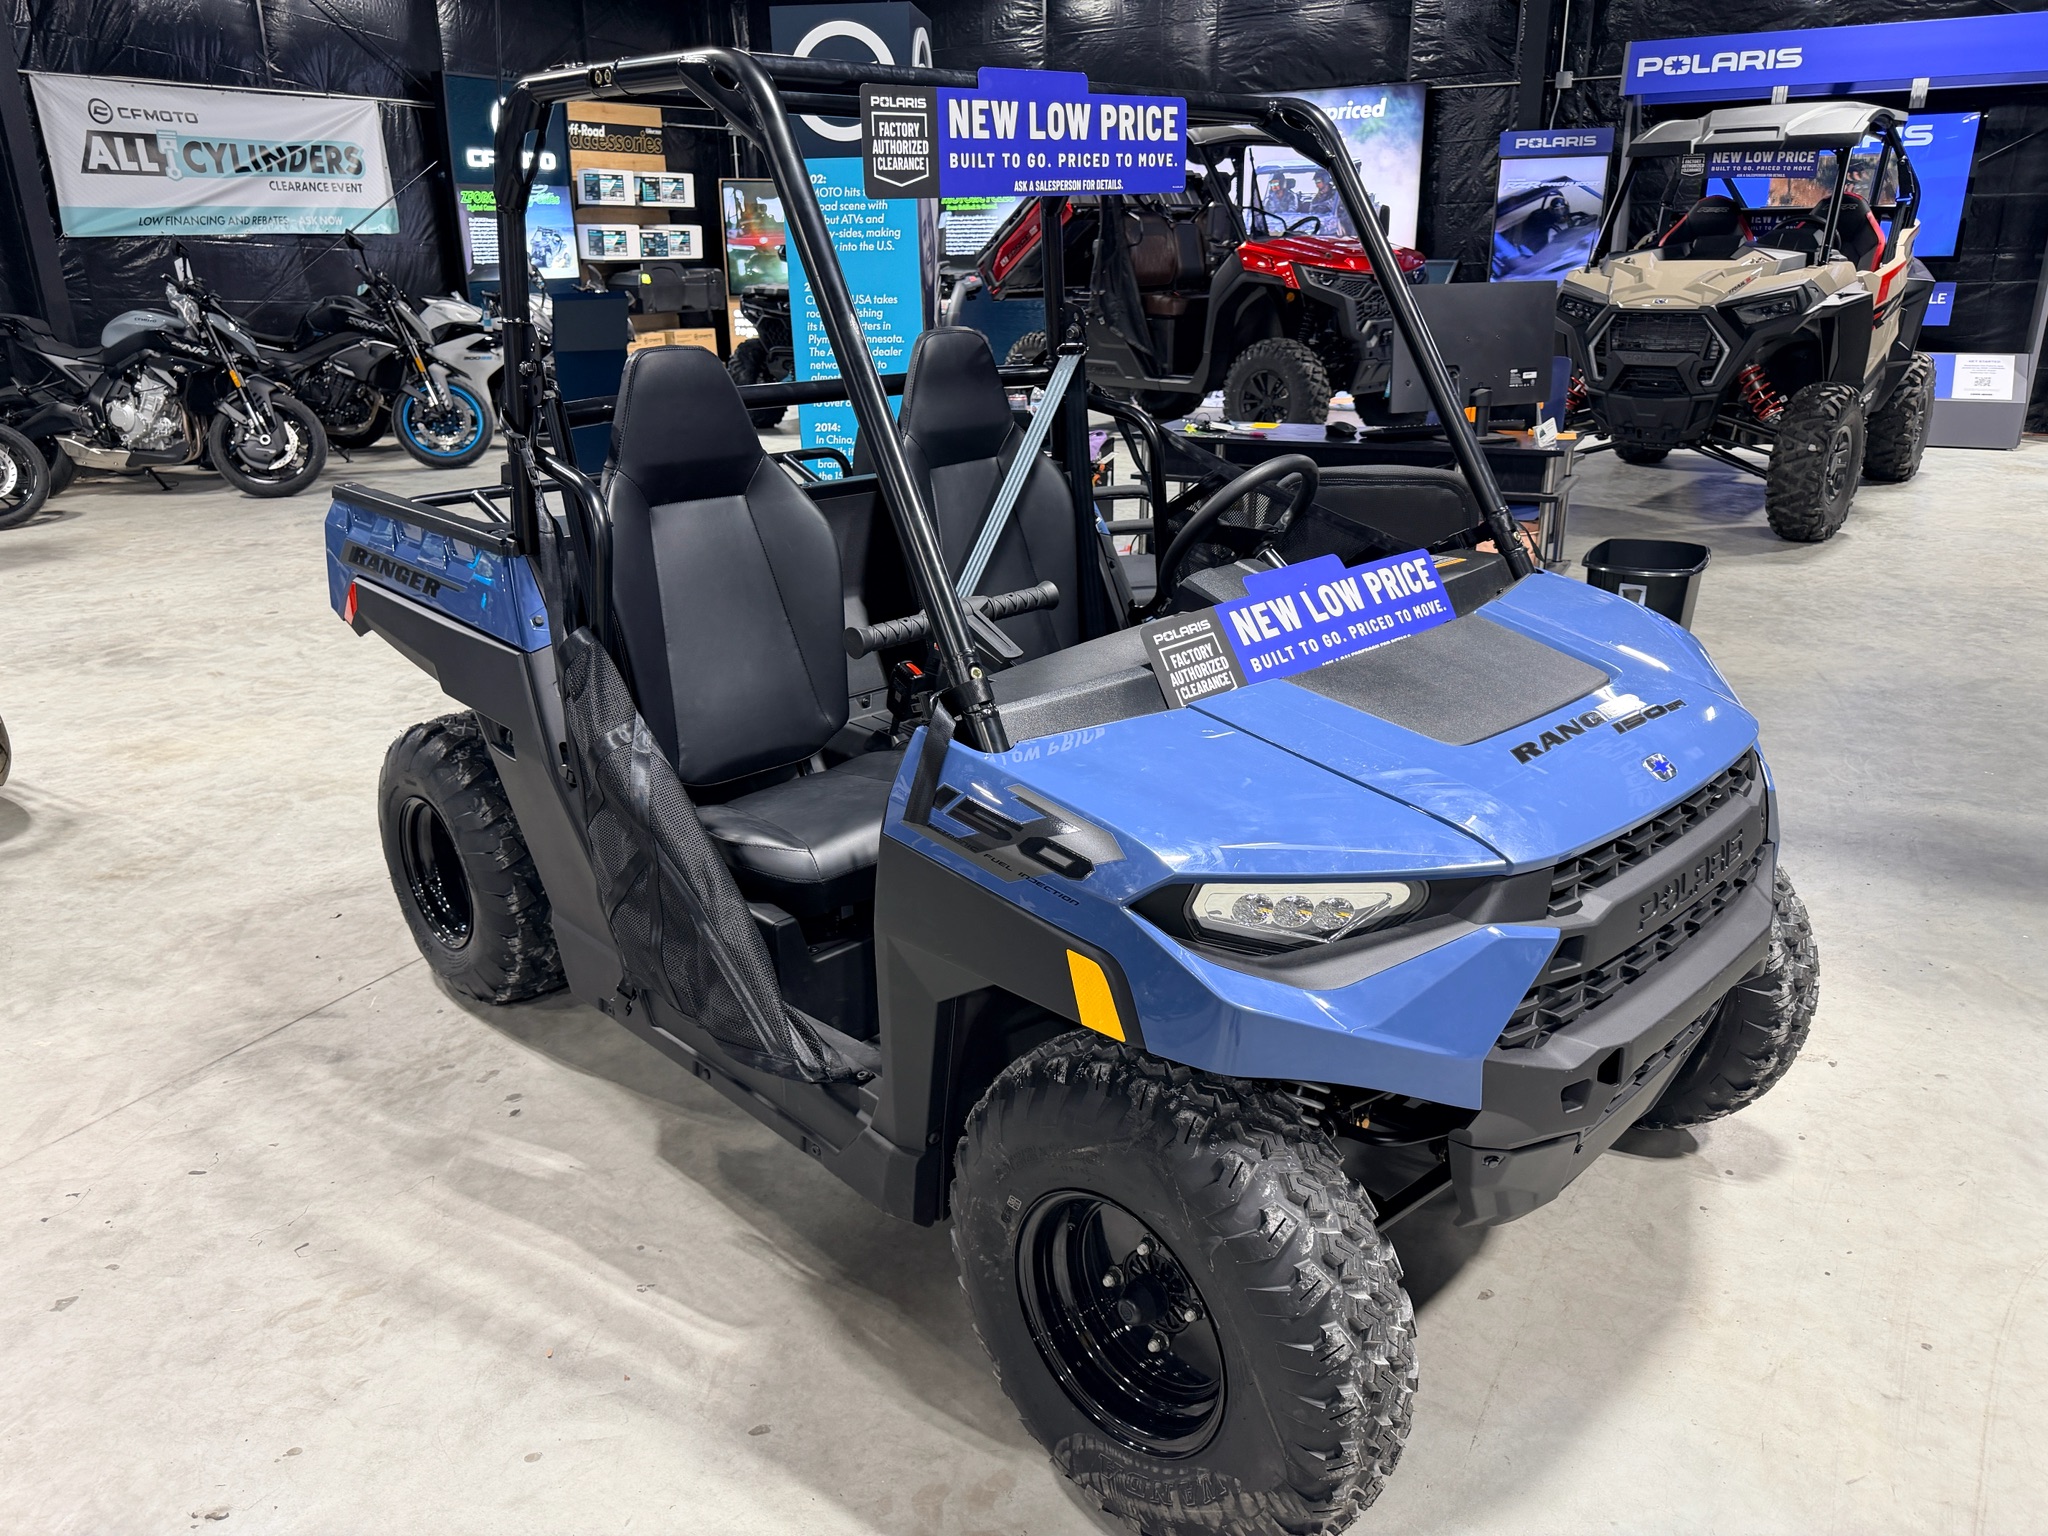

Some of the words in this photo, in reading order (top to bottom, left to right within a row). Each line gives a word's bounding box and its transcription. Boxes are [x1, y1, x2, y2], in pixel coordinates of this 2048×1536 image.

[1637, 47, 1803, 77] POLARIS
[870, 96, 927, 108] POLARIS
[117, 107, 199, 124] CFMOTO
[949, 98, 1018, 139] NEW
[1029, 102, 1091, 140] LOW
[1101, 104, 1178, 141] PRICE
[879, 122, 919, 137] FACTORY
[569, 130, 663, 153] accessories
[872, 139, 929, 154] AUTHORIZED
[1515, 135, 1597, 149] POLARIS
[88, 135, 160, 172] ALL
[182, 140, 364, 176] CYLINDERS
[949, 153, 995, 169] BUILT
[1002, 153, 1020, 168] TO
[1027, 153, 1051, 168] GO.
[1058, 153, 1109, 168] PRICED
[1116, 153, 1131, 167] TO
[1138, 153, 1178, 168] MOVE.
[1712, 152, 1742, 164] NEW
[1744, 151, 1774, 163] LOW
[1776, 151, 1816, 163] PRICE
[877, 157, 925, 170] CLEARANCE
[809, 174, 827, 184] 02:
[1014, 180, 1028, 192] ASK
[1028, 180, 1035, 191] A
[1035, 180, 1081, 191] SALESPERSON
[1082, 180, 1095, 190] FOR
[1096, 179, 1124, 190] DETAILS.
[269, 180, 329, 193] CLEARANCE
[331, 182, 363, 193] EVENT
[844, 187, 861, 197] hits
[820, 201, 838, 211] oad
[840, 203, 866, 211] scene
[867, 199, 888, 210] with
[139, 216, 164, 226] LOW
[165, 215, 226, 226] FINANCING
[228, 216, 250, 226] AND
[252, 215, 288, 226] REBATES
[299, 217, 318, 226] ASK
[319, 216, 343, 226] NOW
[824, 214, 839, 225] but
[841, 214, 864, 225] ATVs
[865, 213, 884, 224] and
[829, 228, 865, 239] y-sides,
[866, 227, 901, 240] making
[839, 242, 858, 251] into
[859, 241, 875, 251] the
[876, 240, 895, 251] U.S.
[873, 294, 898, 304] takes
[857, 307, 884, 320] ishing
[807, 322, 818, 331] its
[882, 321, 892, 331] in
[809, 347, 826, 357] The
[872, 346, 902, 357] dealer
[810, 361, 838, 370] netwo
[877, 360, 887, 369] to
[815, 423, 841, 432] 2014:
[816, 435, 824, 444] In
[826, 435, 855, 446] China,
[350, 546, 442, 598] RANGER
[1229, 595, 1302, 647] NEW
[1300, 576, 1362, 624] LOW
[1361, 557, 1437, 605] PRICE
[1153, 619, 1212, 645] POLARIS
[1250, 645, 1296, 673] BUILT
[1298, 638, 1320, 656] TO
[1321, 630, 1348, 648] GO.
[1347, 613, 1395, 639] PRICED
[1395, 607, 1412, 624] TO
[1414, 599, 1447, 619] MOVE.
[1169, 642, 1214, 669] FACTORY
[1170, 656, 1230, 687] AUTHORIZED
[1180, 672, 1232, 700] CLEARANCE
[1610, 704, 1668, 735] 150
[983, 853, 1013, 871] FUEL
[1638, 828, 1744, 933] POLARIS
[1099, 1452, 1227, 1506] WANDA
